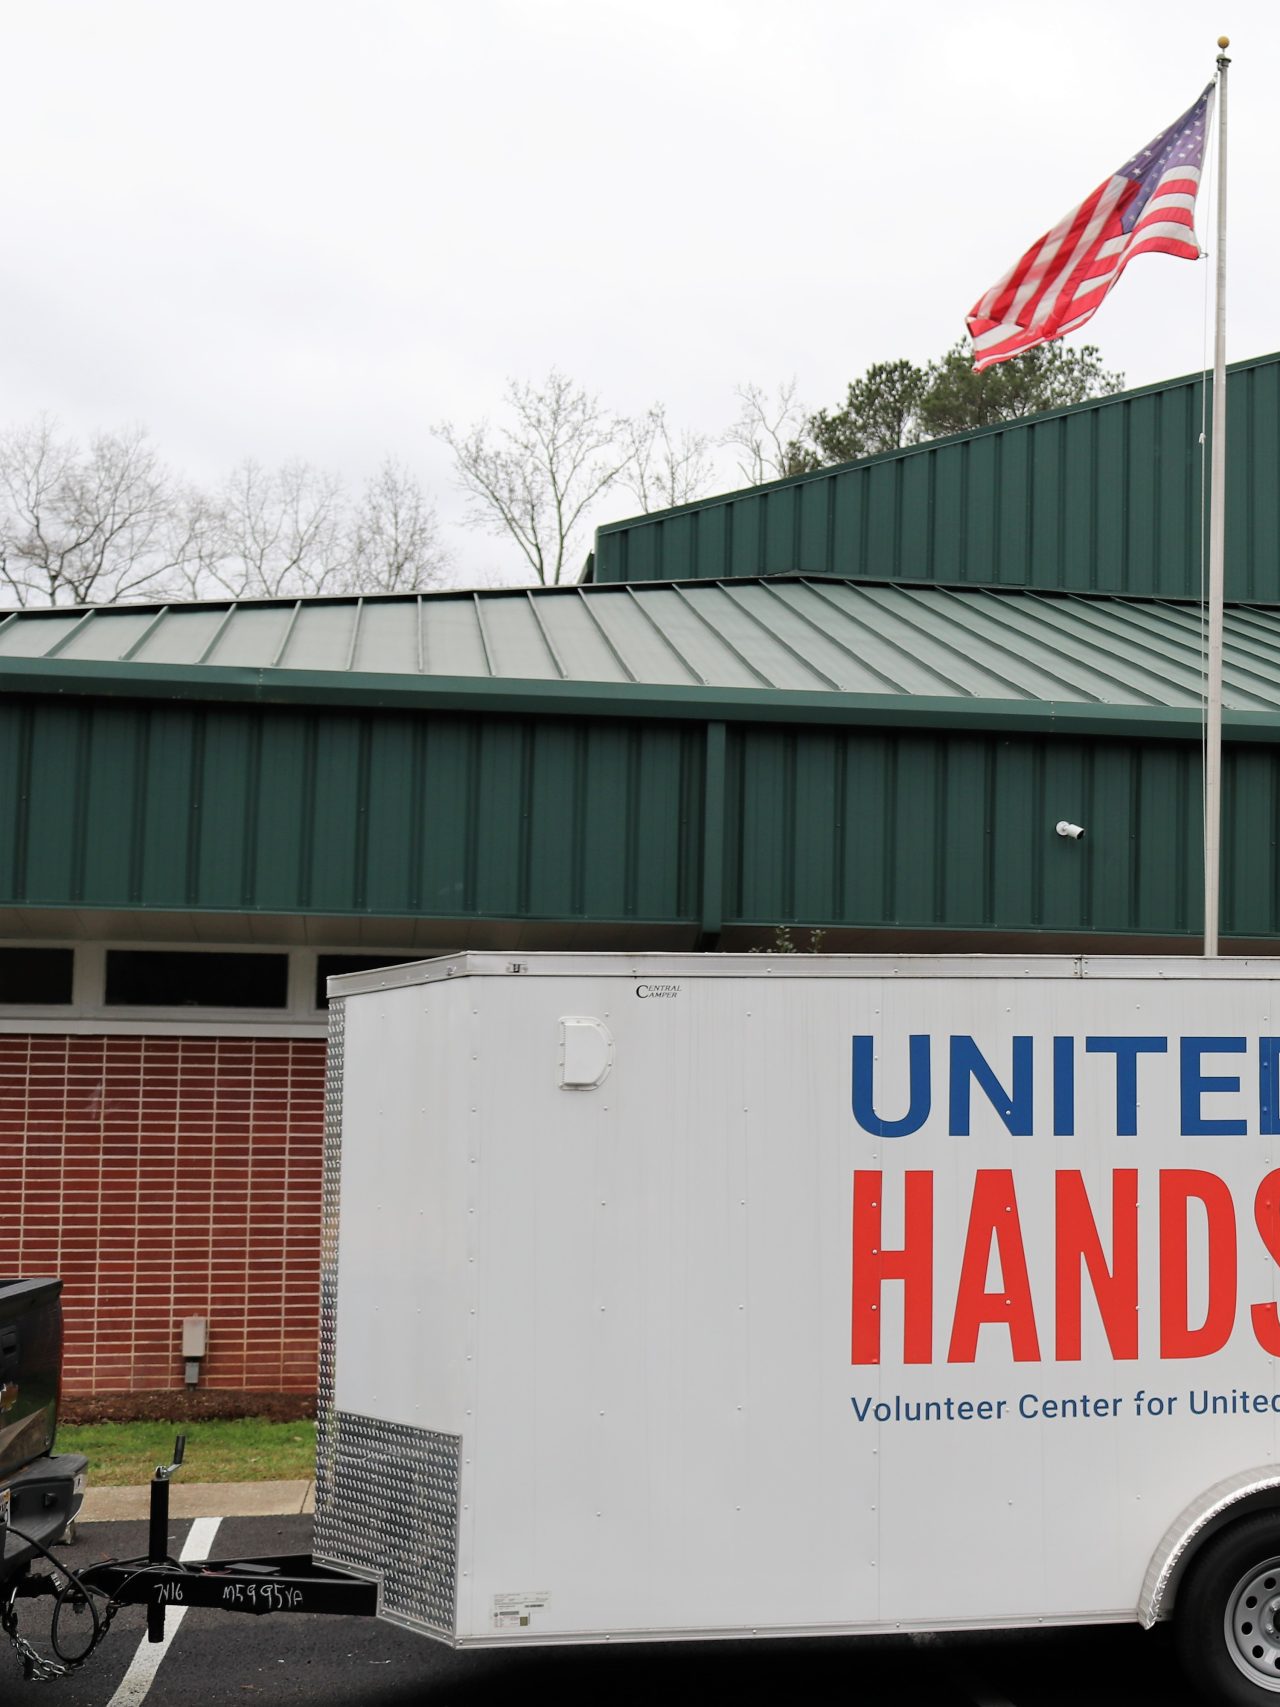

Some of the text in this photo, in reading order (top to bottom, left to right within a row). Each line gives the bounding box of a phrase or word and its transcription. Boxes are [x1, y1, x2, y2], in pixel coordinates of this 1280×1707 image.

[851, 1395, 1007, 1422] Volunteer
[1019, 1393, 1122, 1420] Center
[1135, 1391, 1177, 1416] for
